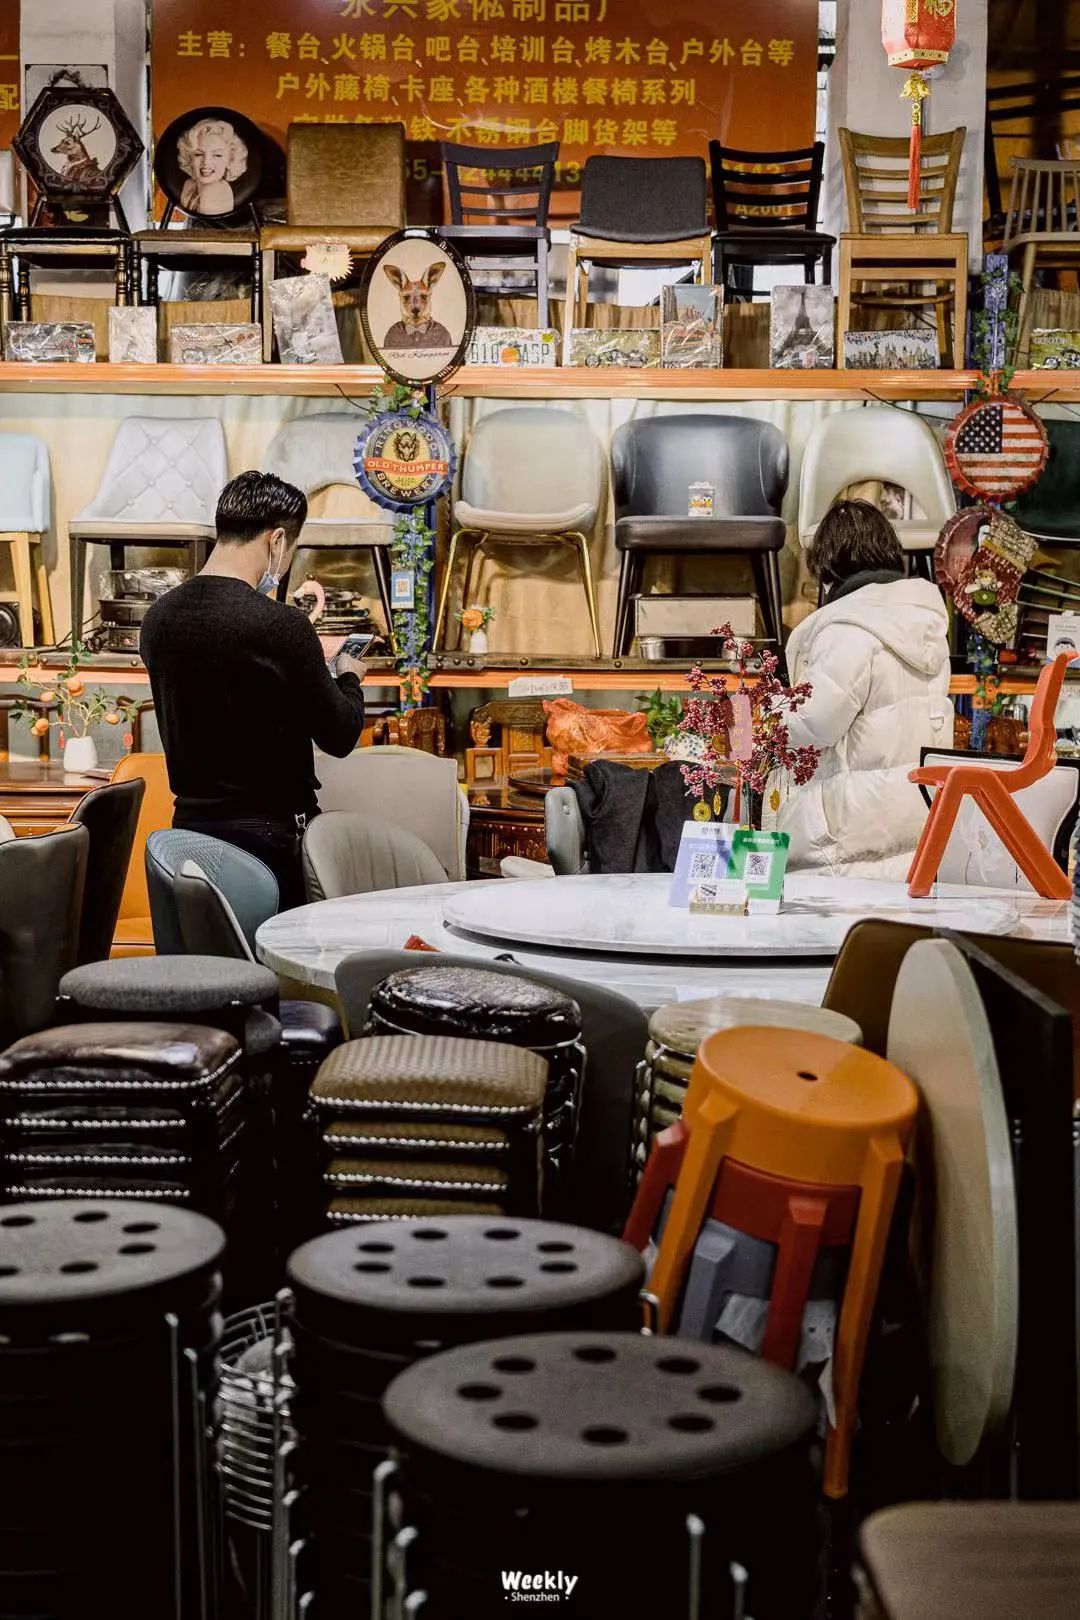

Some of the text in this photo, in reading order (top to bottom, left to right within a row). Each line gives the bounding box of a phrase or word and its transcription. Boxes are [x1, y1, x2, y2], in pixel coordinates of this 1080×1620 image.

[367, 460, 445, 474] OLD THUMPER
[376, 472, 435, 498] BREWERY
